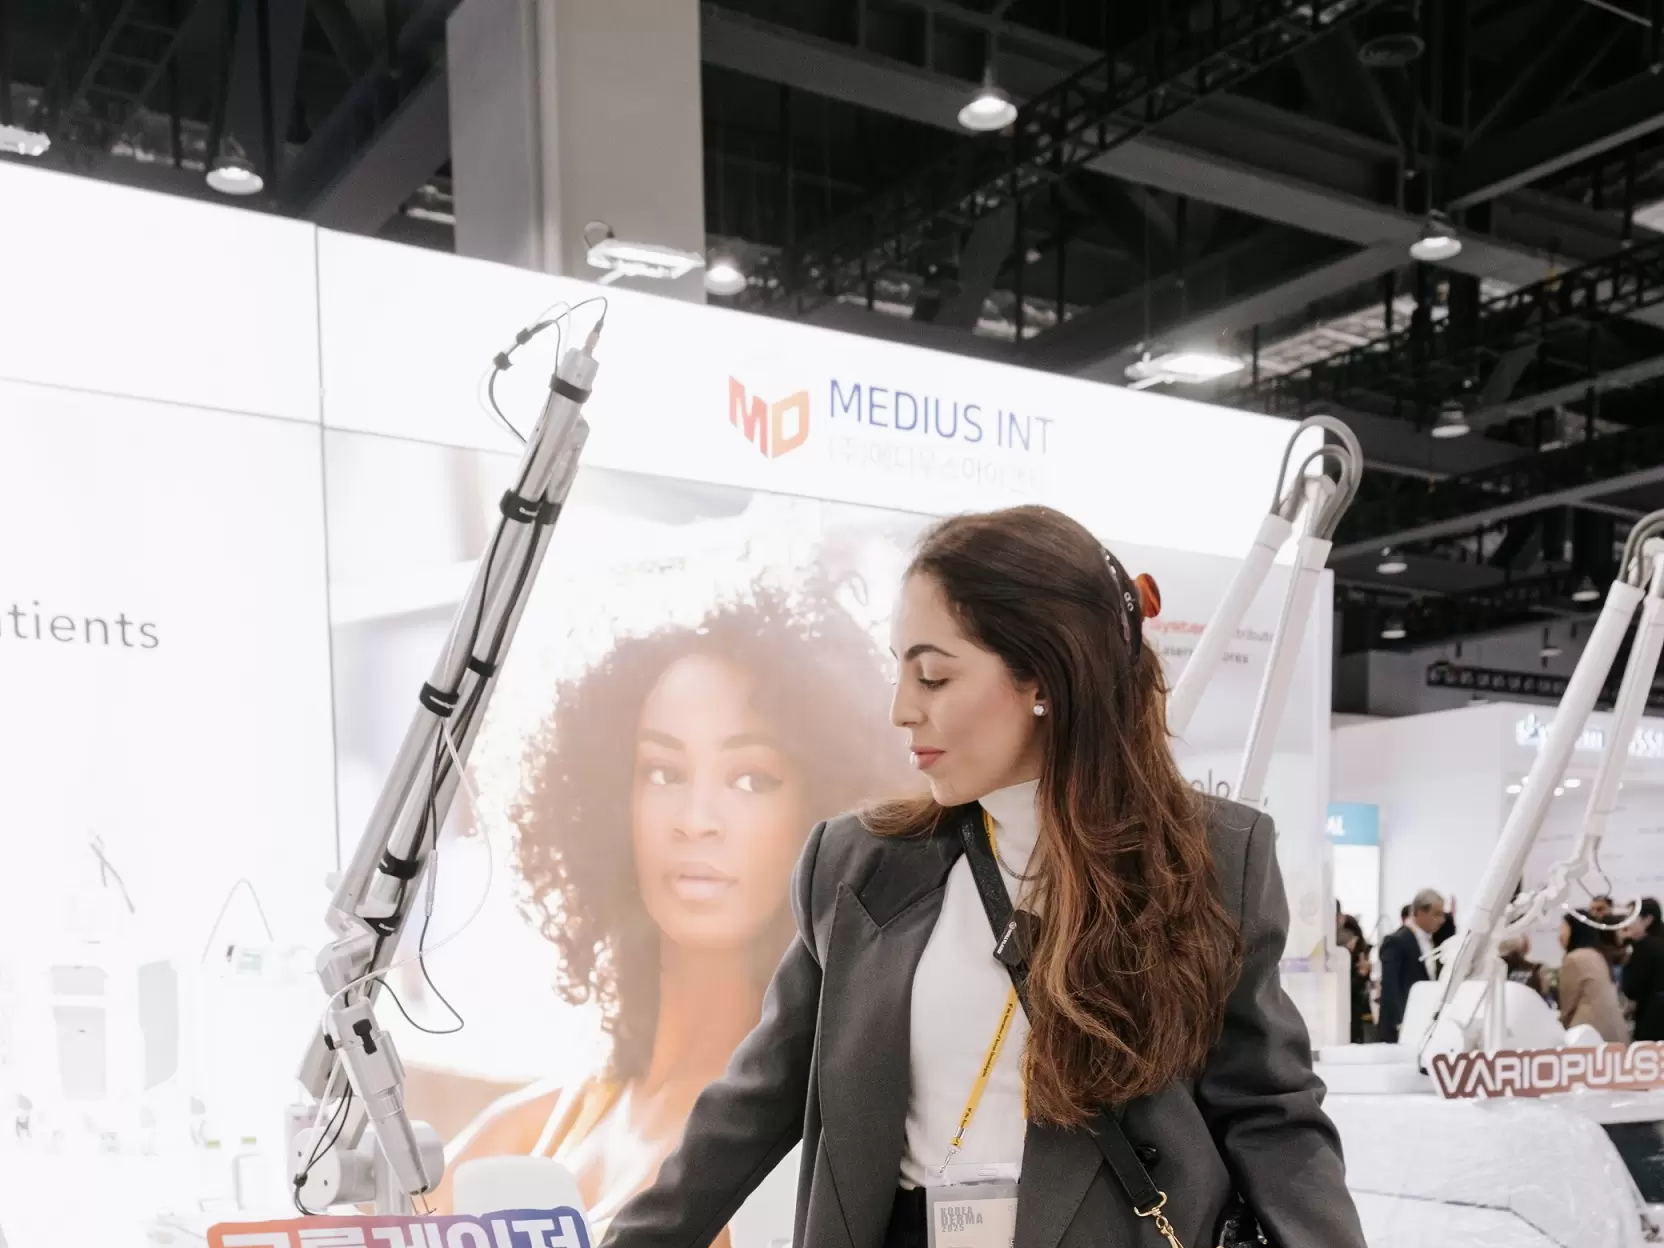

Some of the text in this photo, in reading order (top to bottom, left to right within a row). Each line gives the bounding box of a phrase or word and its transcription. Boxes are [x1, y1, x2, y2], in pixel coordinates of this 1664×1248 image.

[830, 379, 1055, 455] MEDIUS INT
[0, 600, 159, 649] tients
[1436, 1050, 1664, 1094] VARIOPULS
[940, 1206, 973, 1217] KOREA
[940, 1211, 984, 1226] DERMA
[941, 1224, 965, 1233] 2025
